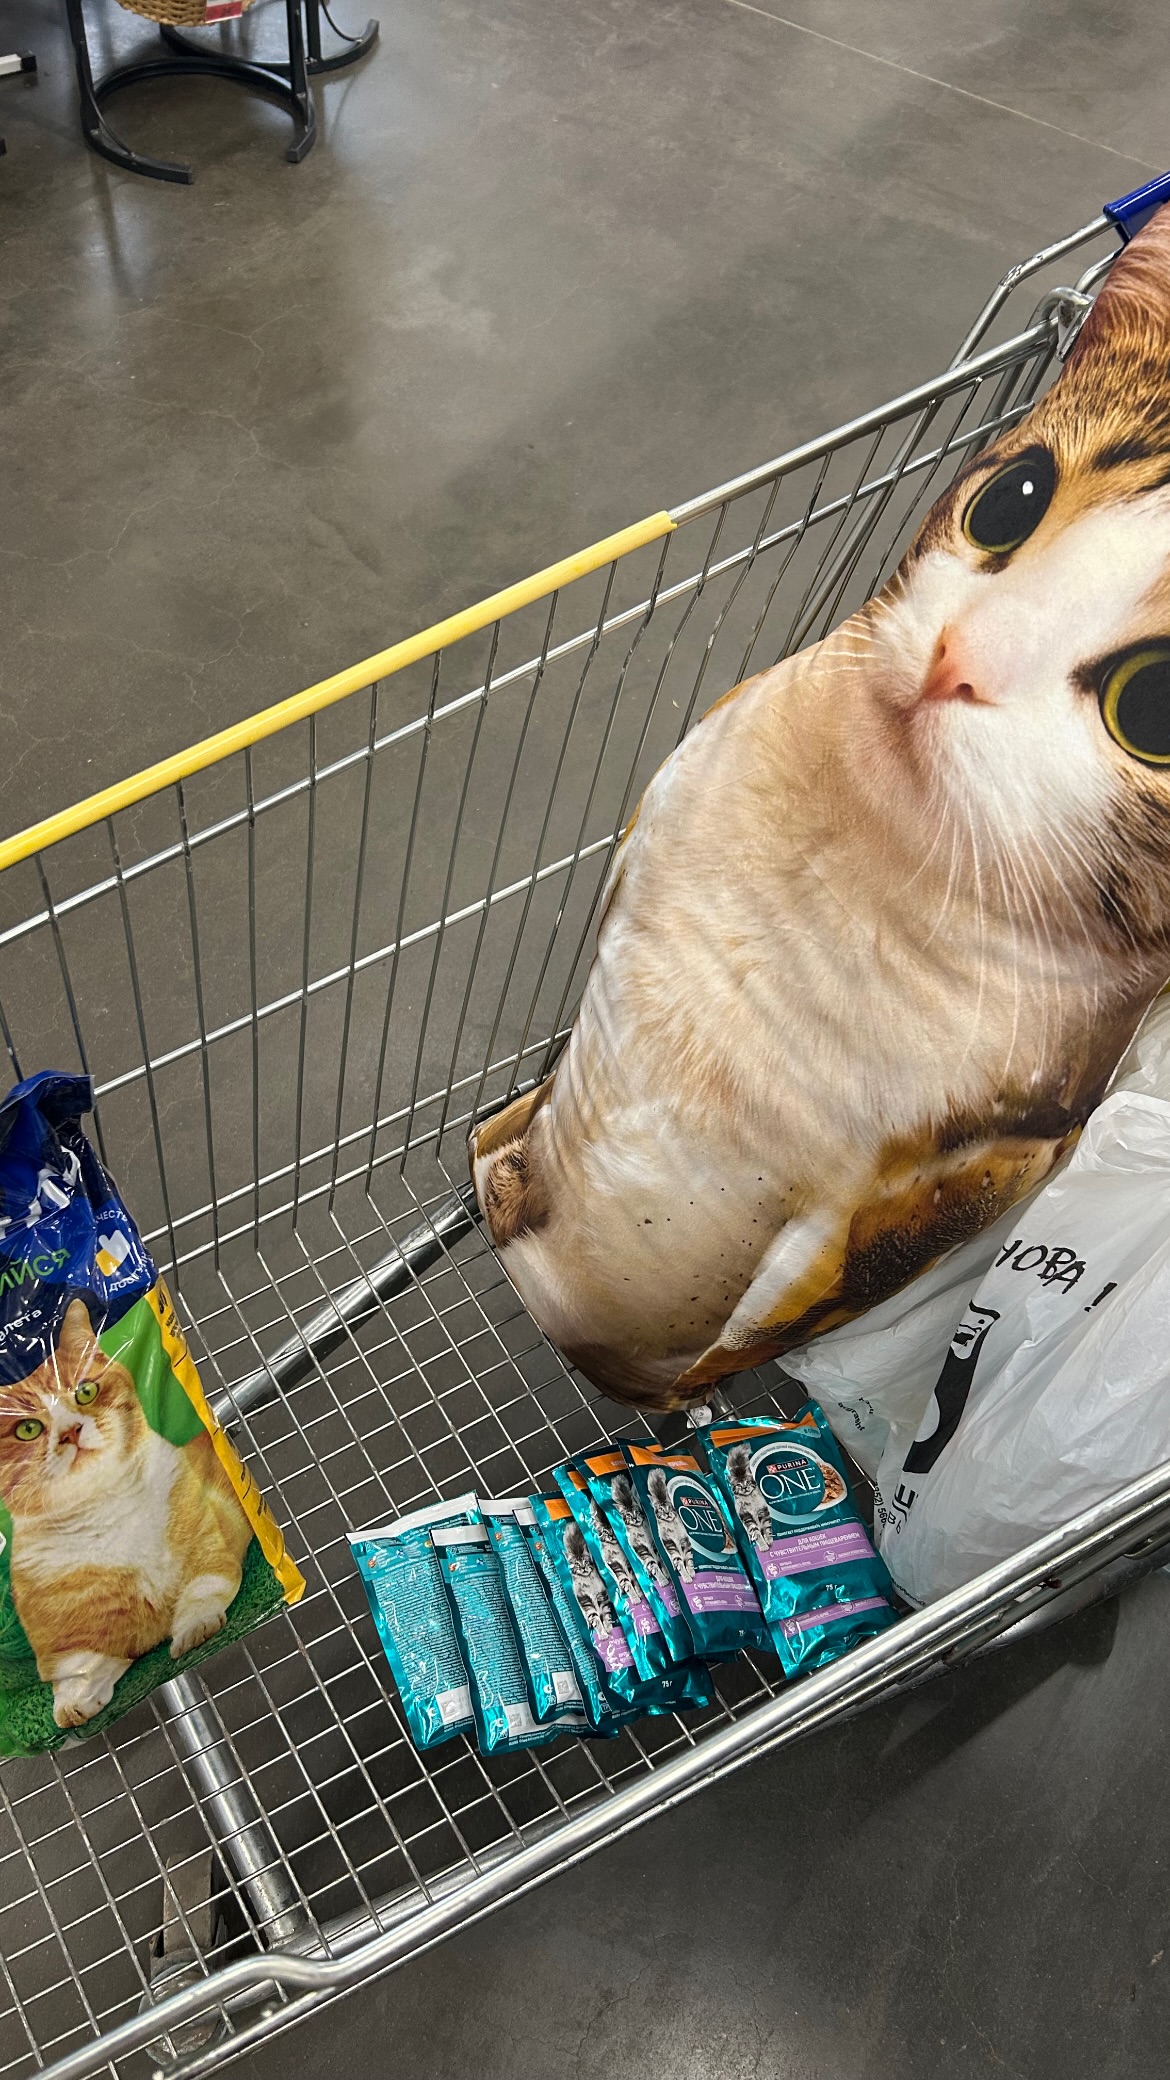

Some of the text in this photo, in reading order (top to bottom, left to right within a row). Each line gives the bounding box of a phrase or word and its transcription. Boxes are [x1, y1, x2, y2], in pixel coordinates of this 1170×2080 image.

[776, 1459, 808, 1471] PURINA
[759, 1467, 821, 1500] ONE
[688, 1498, 710, 1507] PURINA
[678, 1506, 722, 1533] ONE
[774, 1542, 819, 1557] ЧУВСТВИТЕЛЬНЫМ
[818, 1532, 861, 1549] ПИЩЕВАРЕНИЕМ
[798, 1533, 827, 1546] ДЛЯ КОШЕК
[662, 1680, 670, 1688] 75
